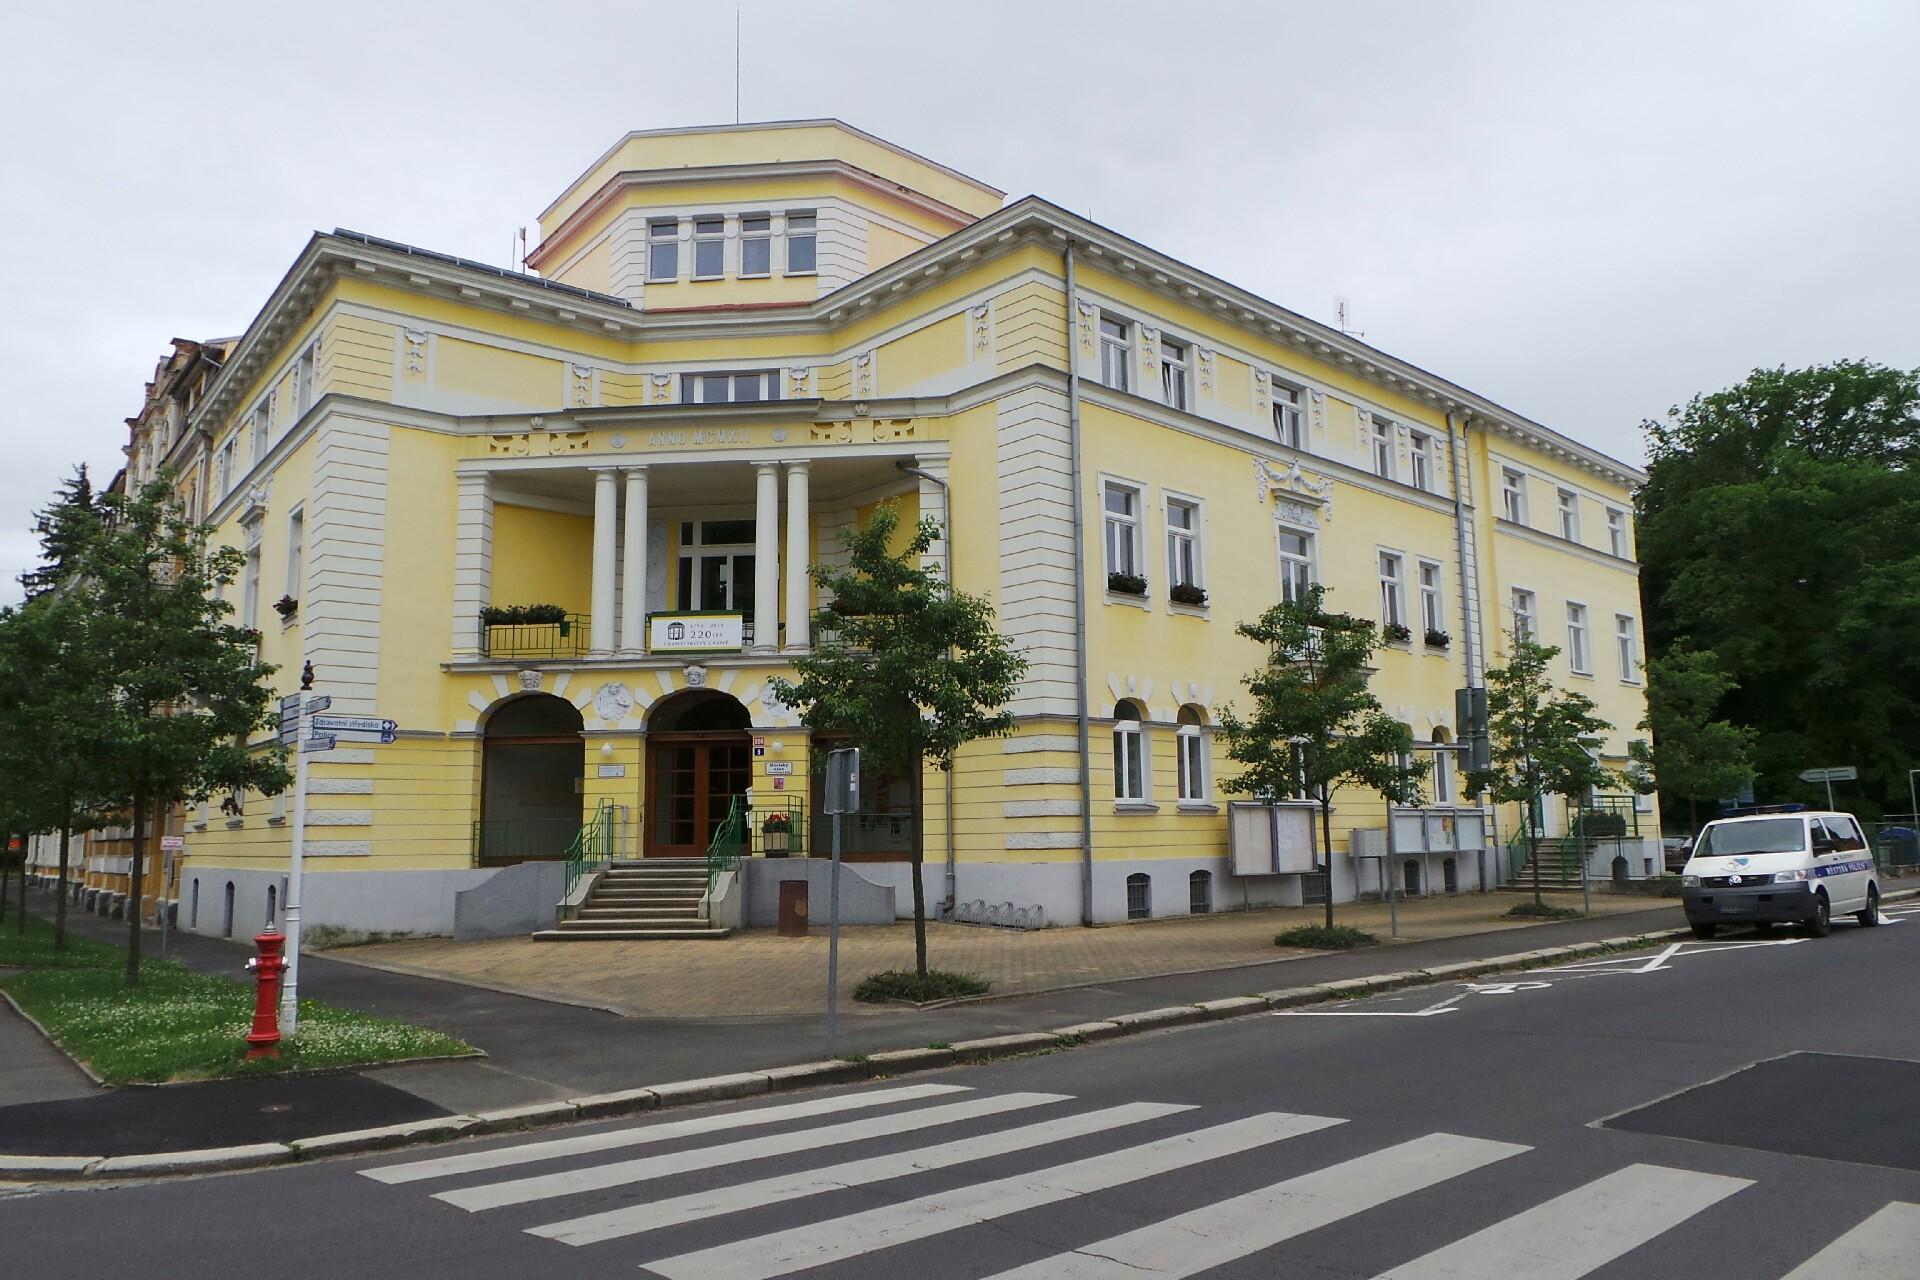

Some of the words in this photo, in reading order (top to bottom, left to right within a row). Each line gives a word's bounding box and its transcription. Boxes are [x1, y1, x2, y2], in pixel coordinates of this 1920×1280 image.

[648, 431, 687, 447] ANNO
[690, 630, 712, 639] 220
[314, 718, 348, 729] Zdravotní
[349, 719, 379, 730] středisko
